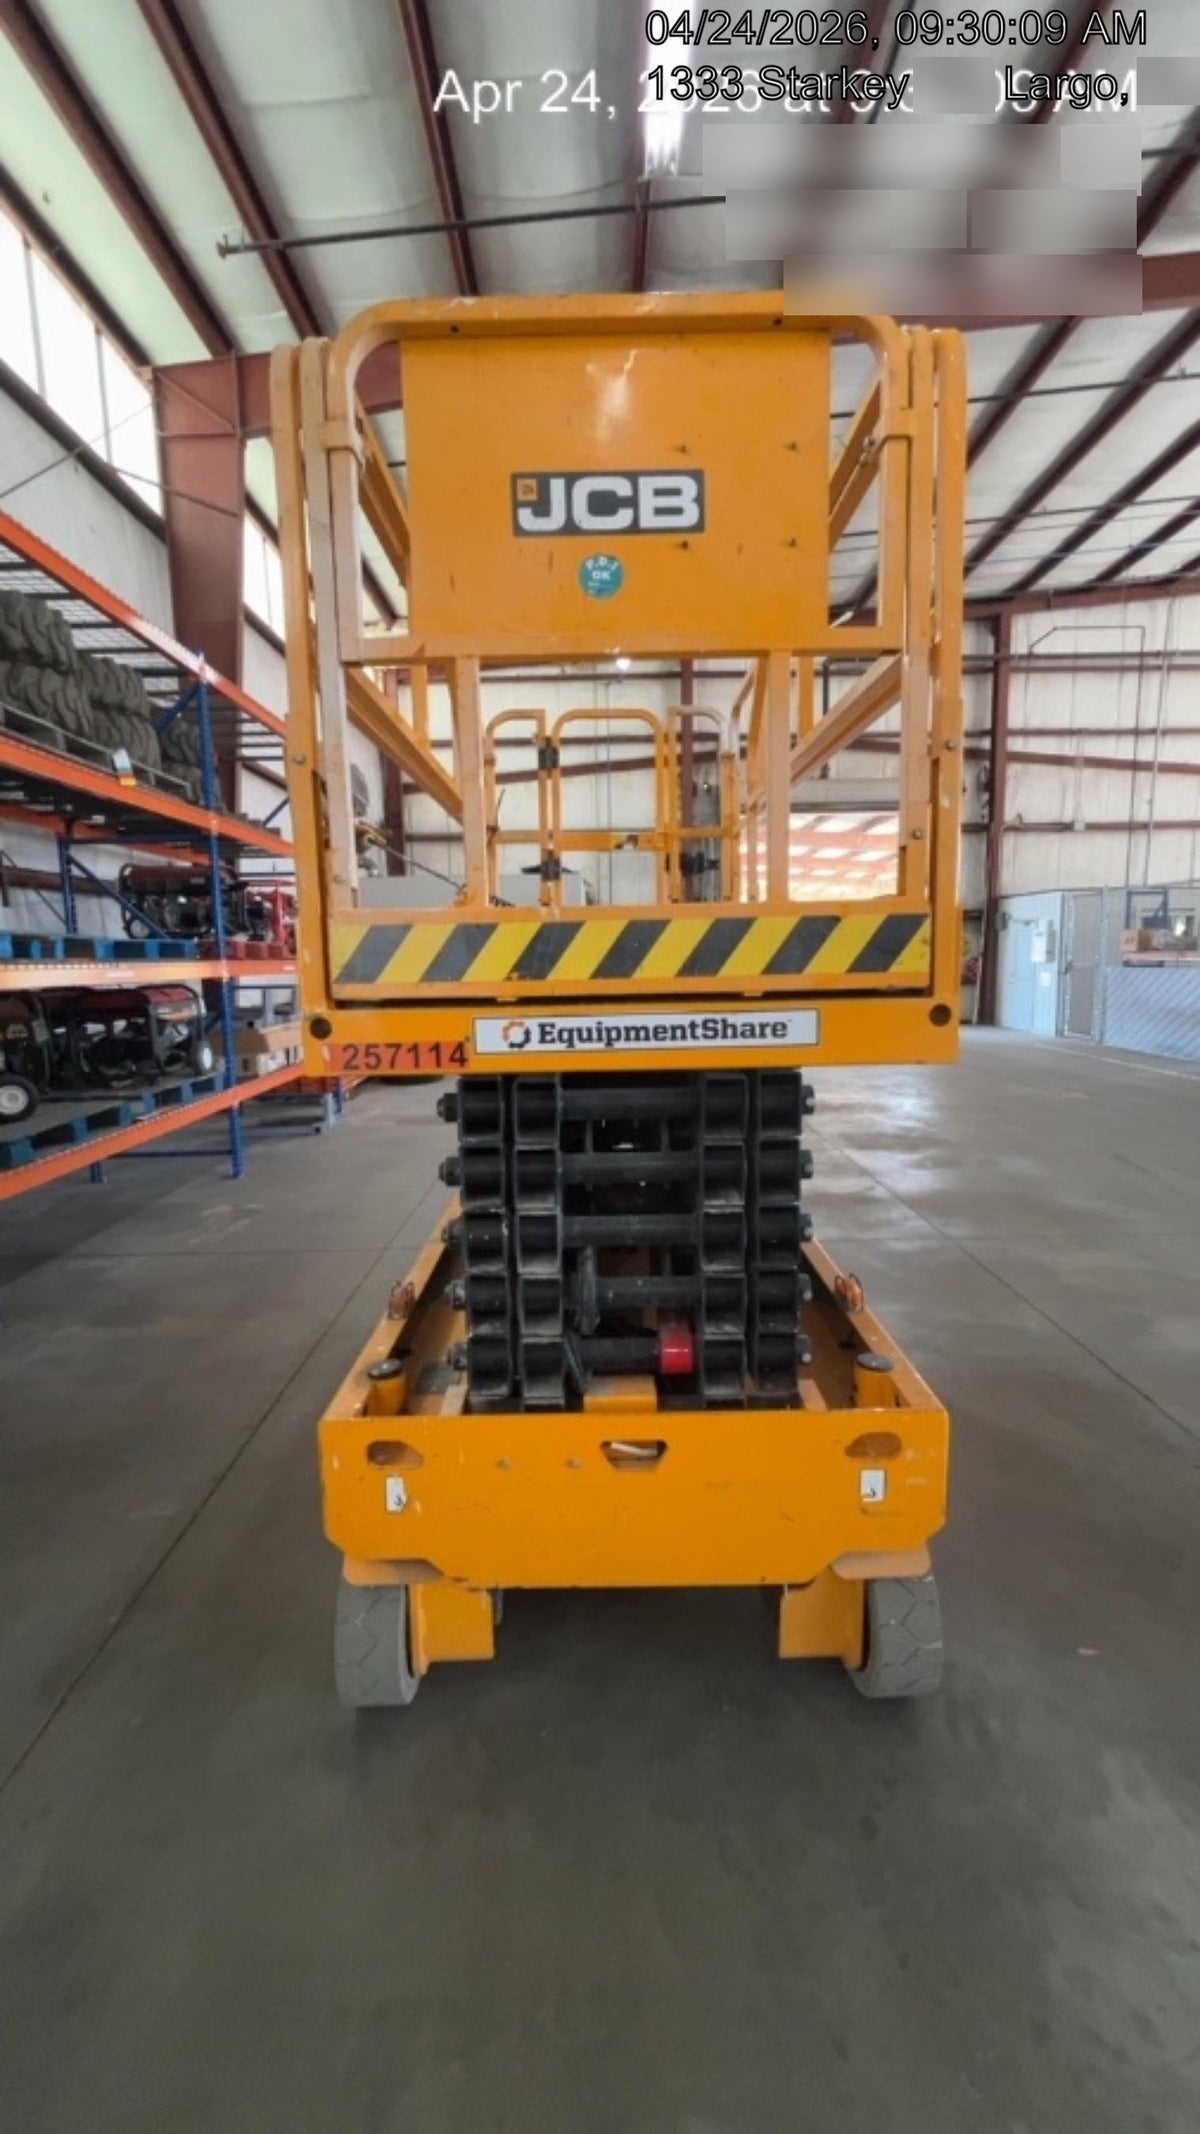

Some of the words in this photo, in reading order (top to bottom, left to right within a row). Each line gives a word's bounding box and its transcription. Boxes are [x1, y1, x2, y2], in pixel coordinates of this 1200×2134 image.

[516, 476, 700, 532] JCB
[538, 1018, 788, 1047] EquipmentShare
[342, 1041, 468, 1071] 257114
